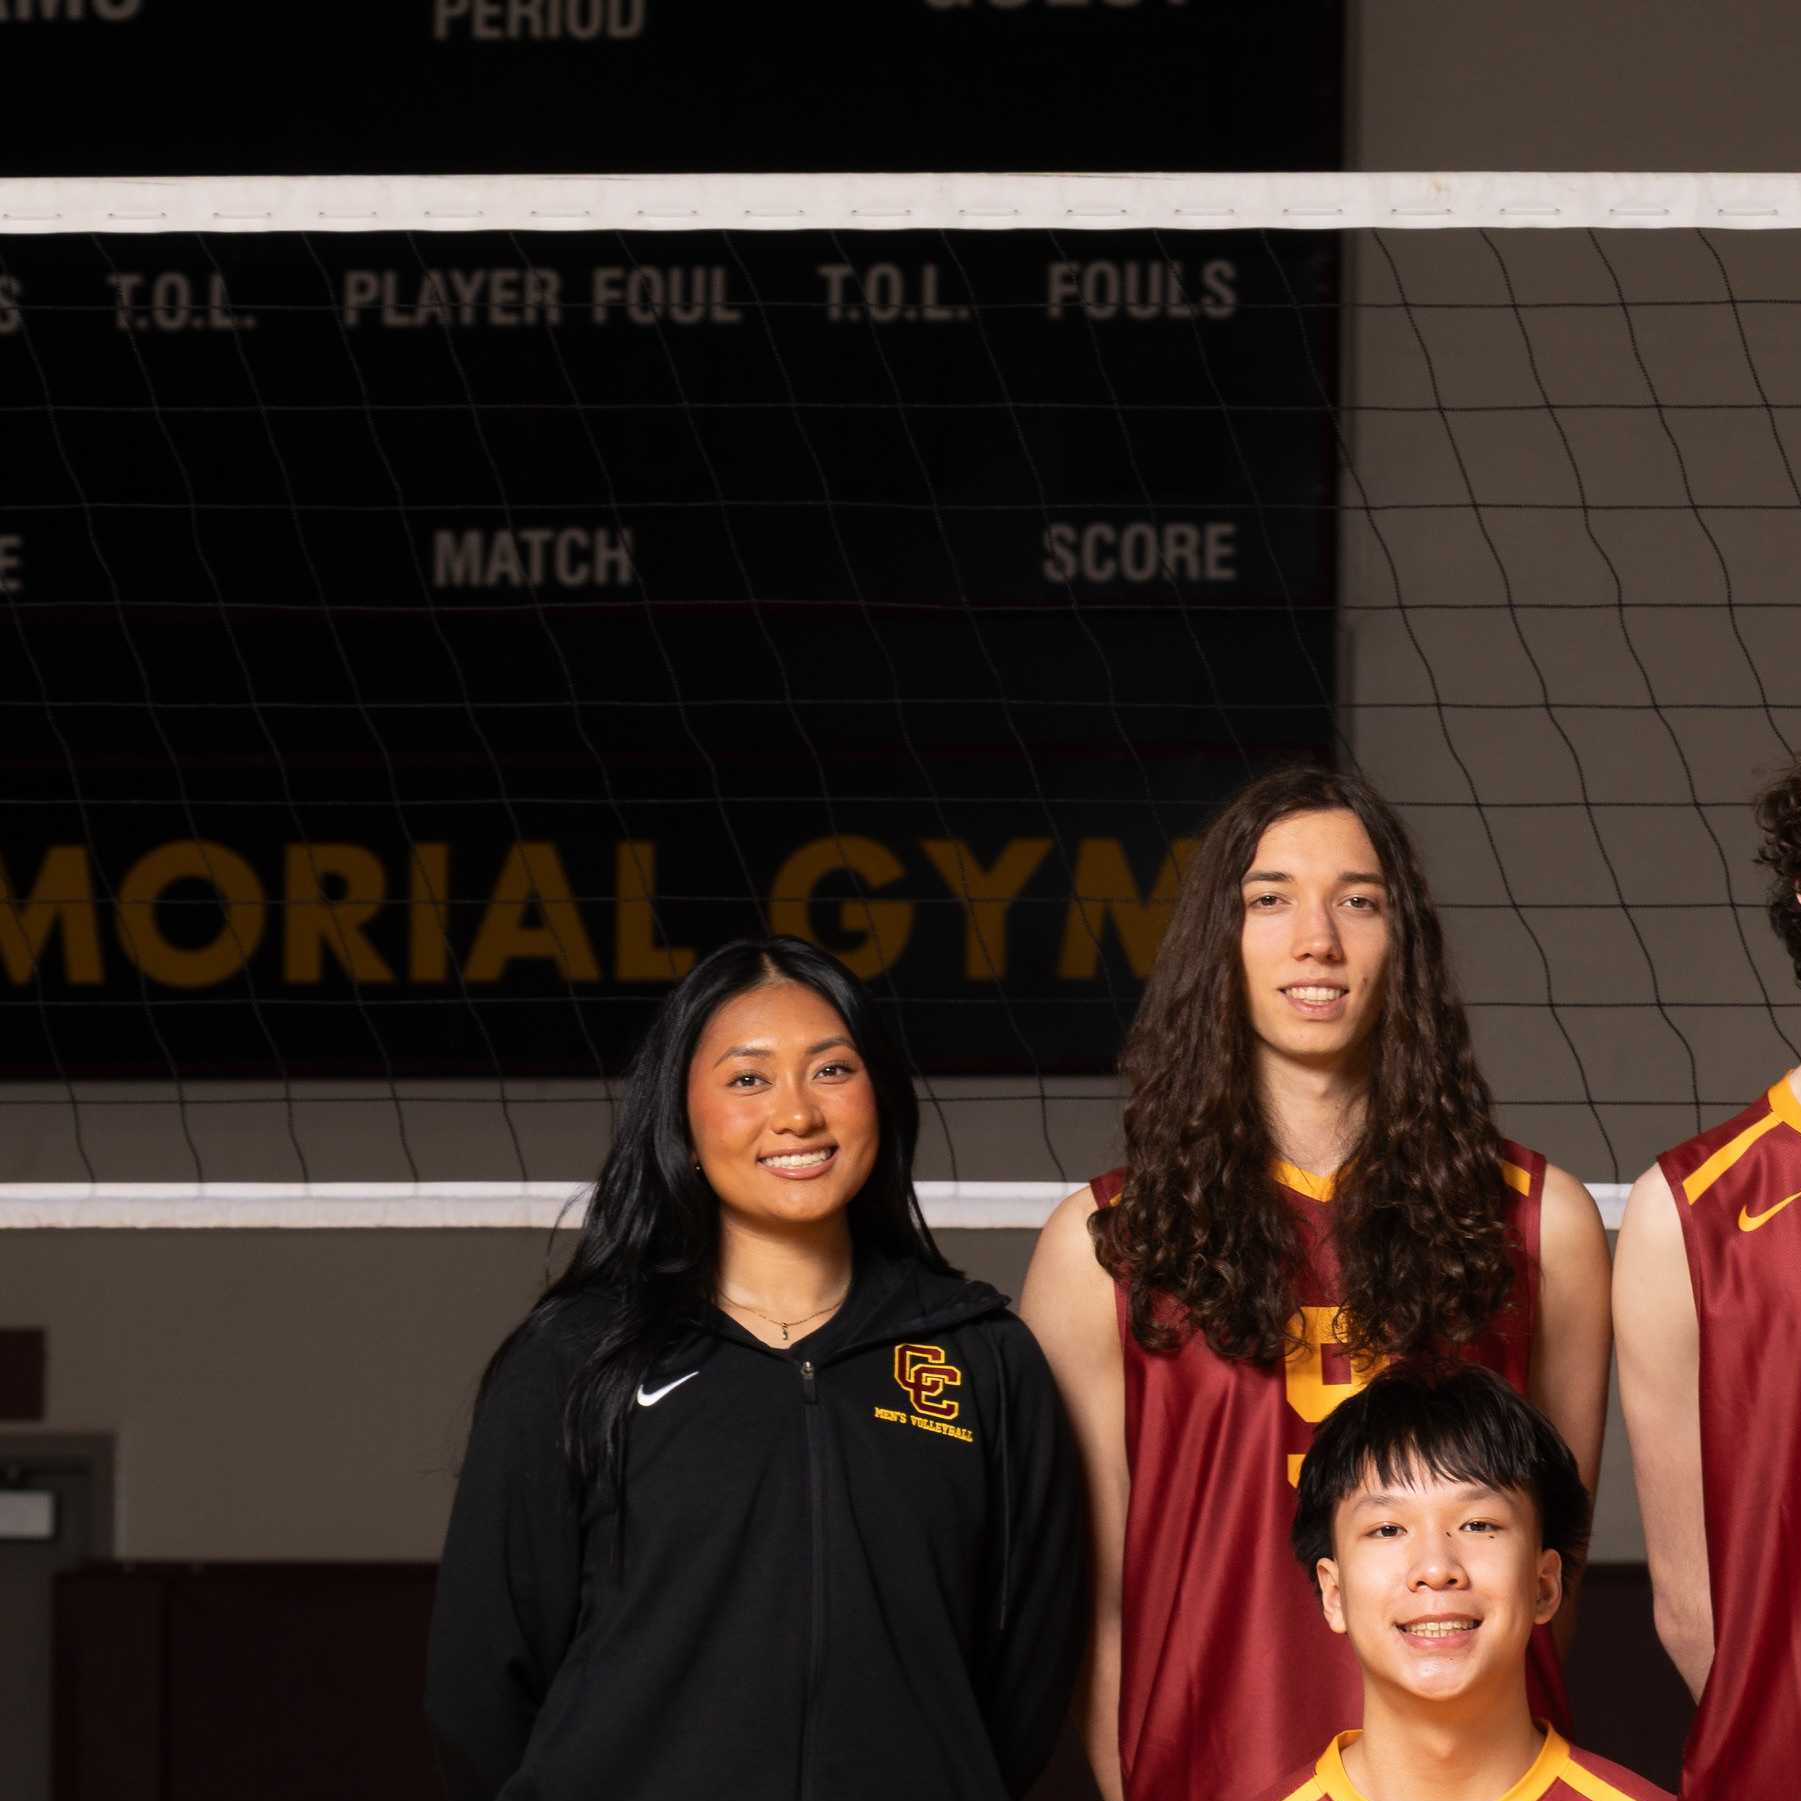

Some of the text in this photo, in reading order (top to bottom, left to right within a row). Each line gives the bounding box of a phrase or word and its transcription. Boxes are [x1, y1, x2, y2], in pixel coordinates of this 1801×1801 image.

[434, 0, 645, 41] PERIOD
[107, 271, 256, 331] T.O.L.
[344, 265, 742, 328] PLAYER FOUL
[818, 262, 970, 322] T.O.L.
[1048, 259, 1238, 320] FOULS
[433, 526, 634, 588] MATCH
[1042, 521, 1237, 584] SCORE
[768, 832, 1206, 984] GYM
[894, 1342, 961, 1420] CC
[874, 1406, 974, 1442] MEN'S VOLLEYBALL
